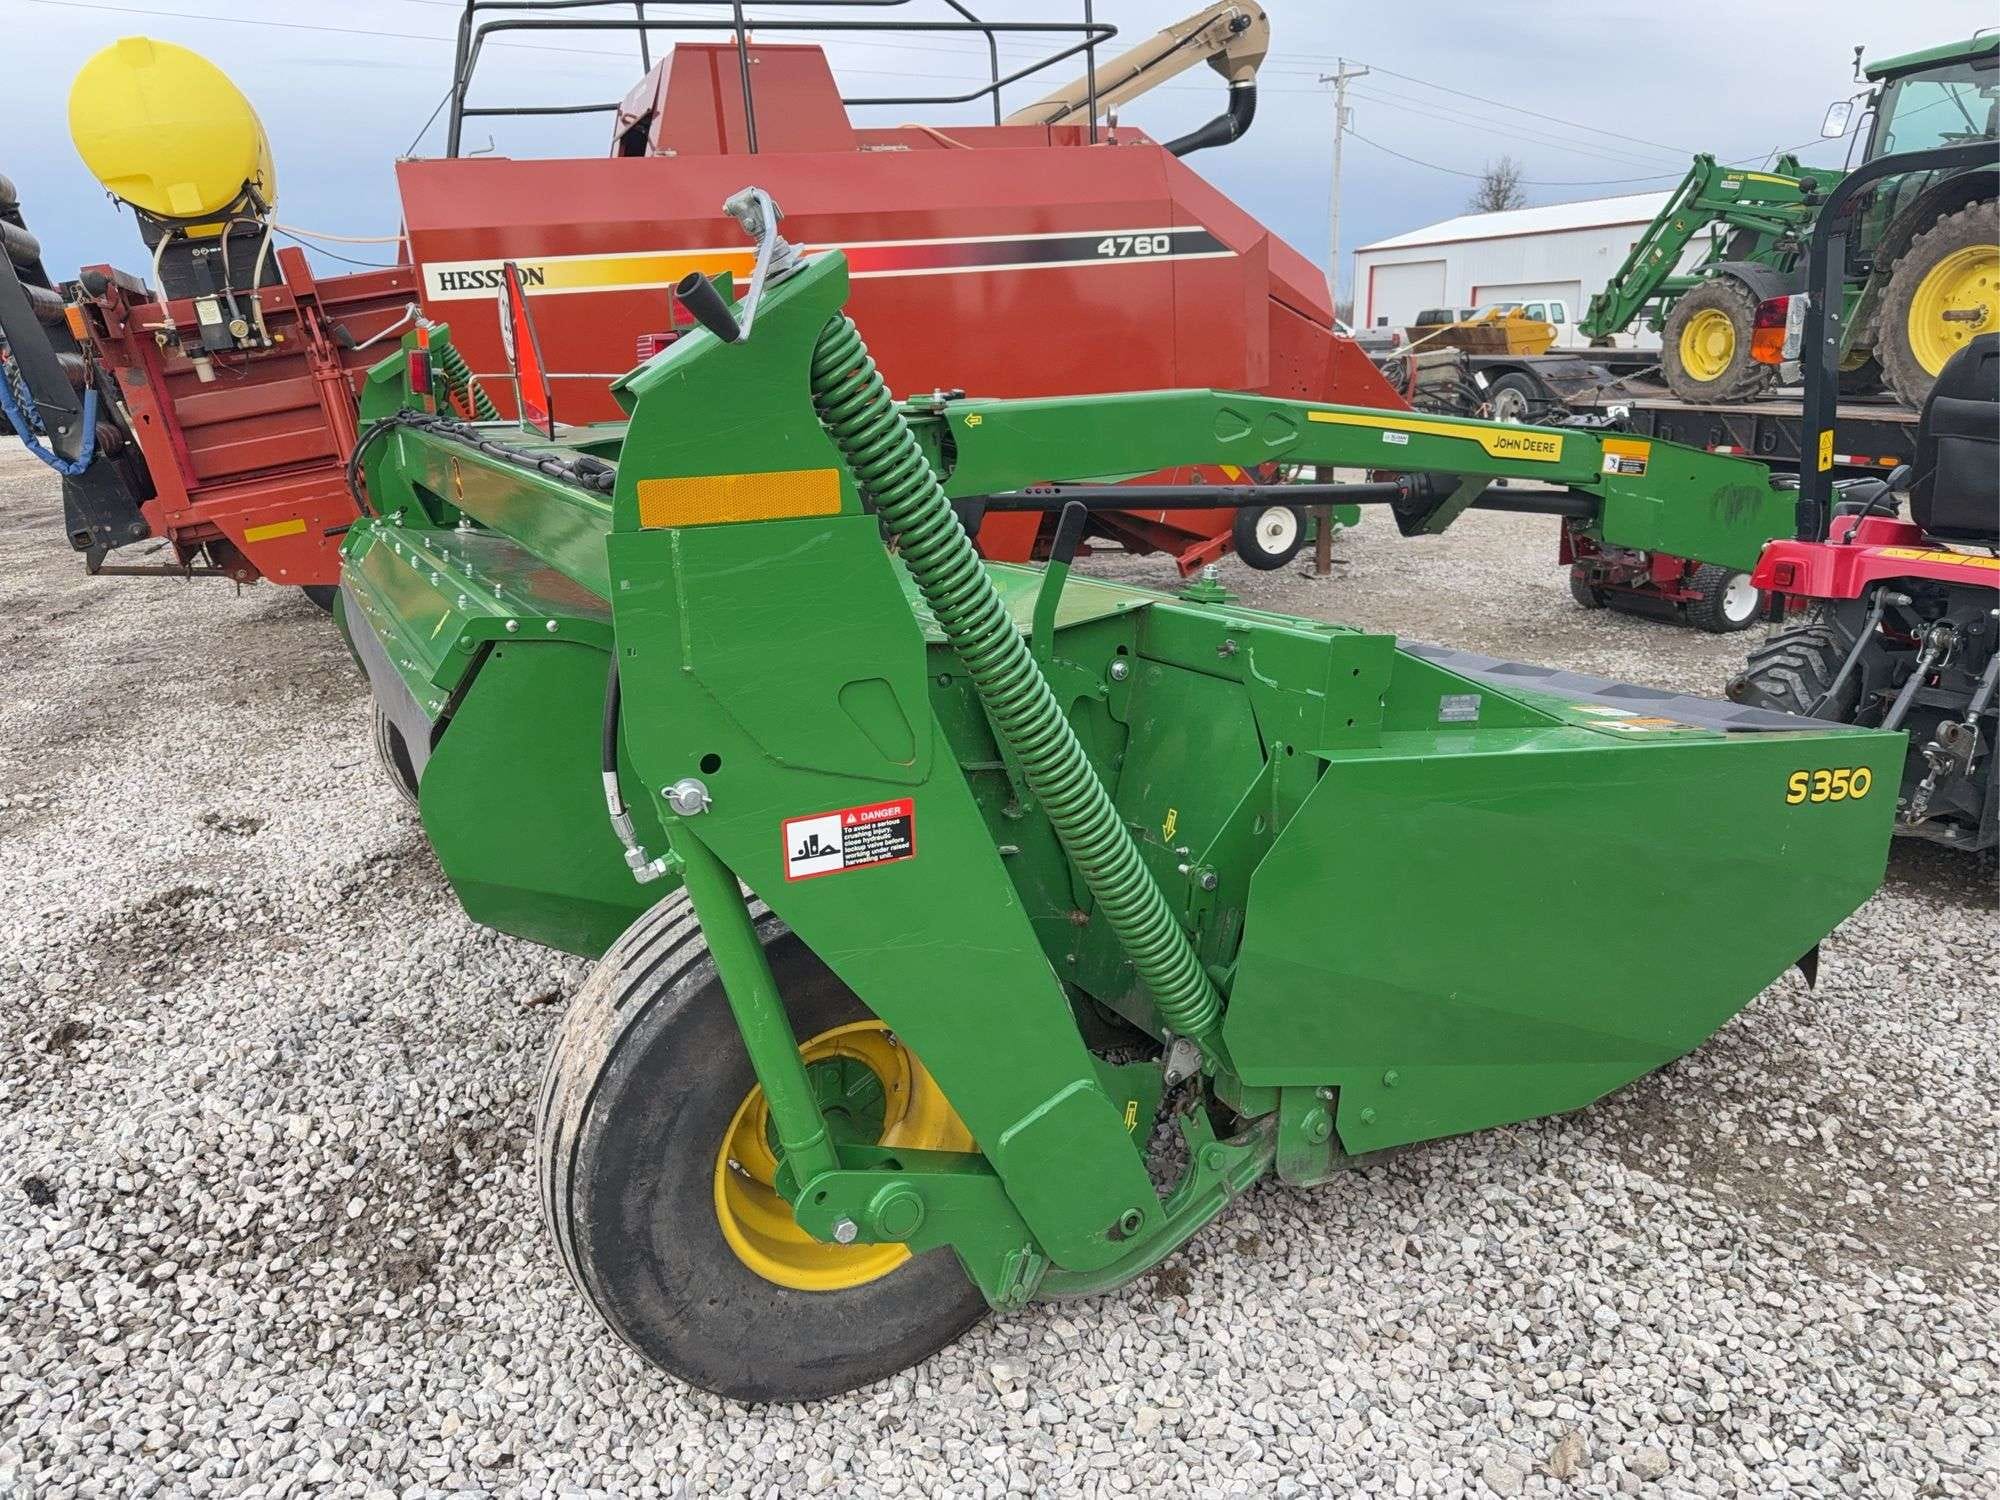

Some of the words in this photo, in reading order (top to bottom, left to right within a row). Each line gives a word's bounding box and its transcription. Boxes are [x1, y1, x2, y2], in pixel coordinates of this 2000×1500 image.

[1097, 235, 1170, 256] 4760
[1494, 436, 1521, 450] JOHN
[1523, 439, 1556, 453] DEERE
[1785, 766, 1872, 805] S350
[861, 806, 901, 820] DANGER
[844, 830, 872, 840] crushing
